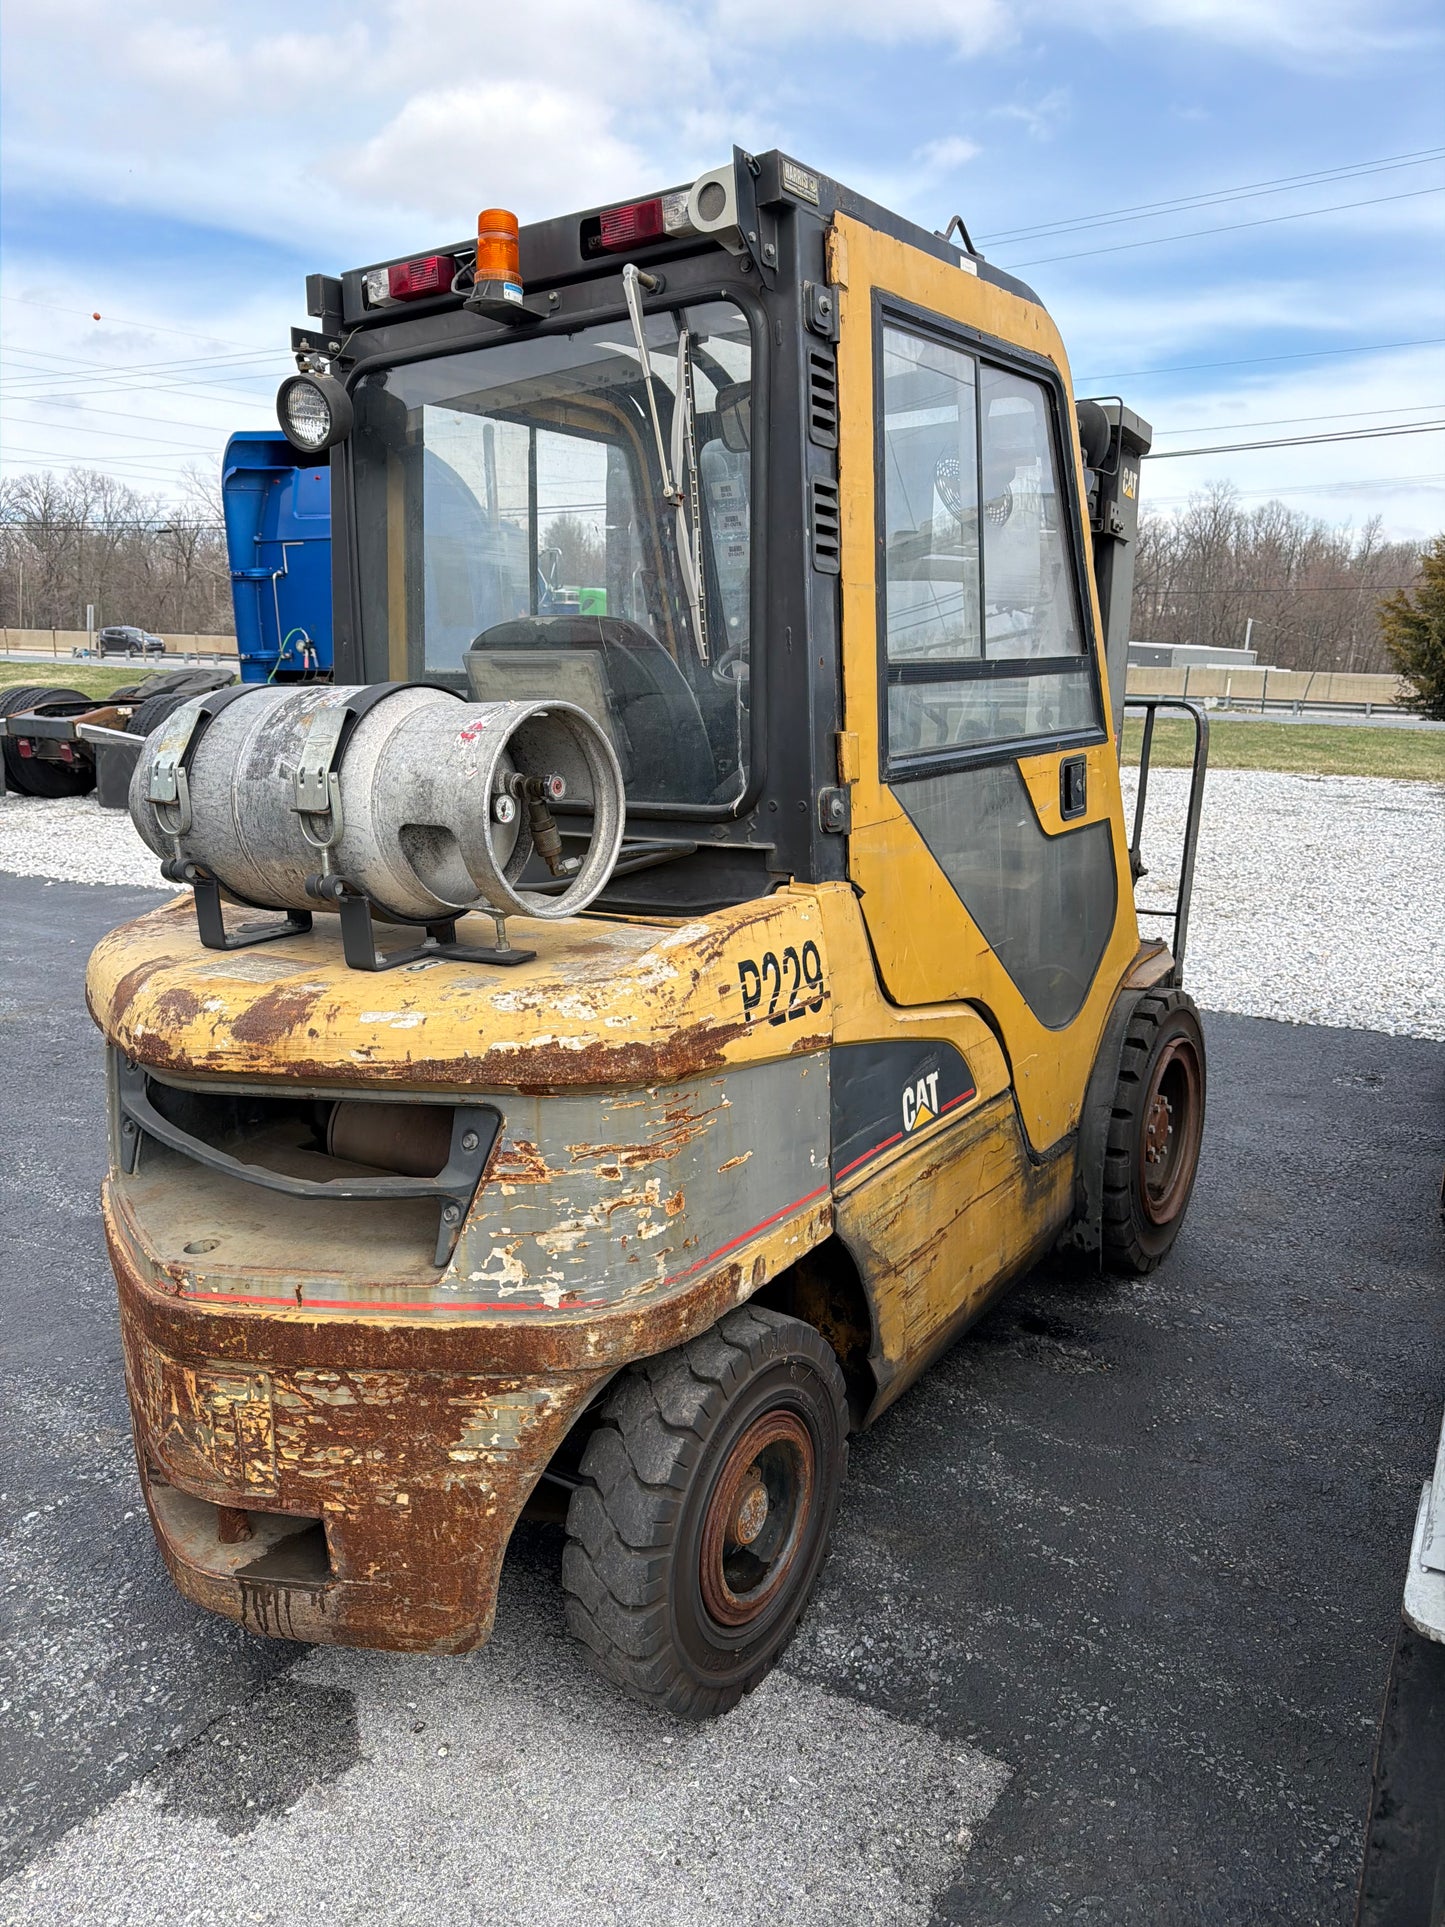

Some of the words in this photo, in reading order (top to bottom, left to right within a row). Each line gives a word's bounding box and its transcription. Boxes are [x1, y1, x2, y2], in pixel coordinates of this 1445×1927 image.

[785, 162, 808, 188] HARRIS
[1122, 467, 1138, 500] CAT
[738, 939, 824, 1027] P229
[902, 1070, 939, 1131] CAT
